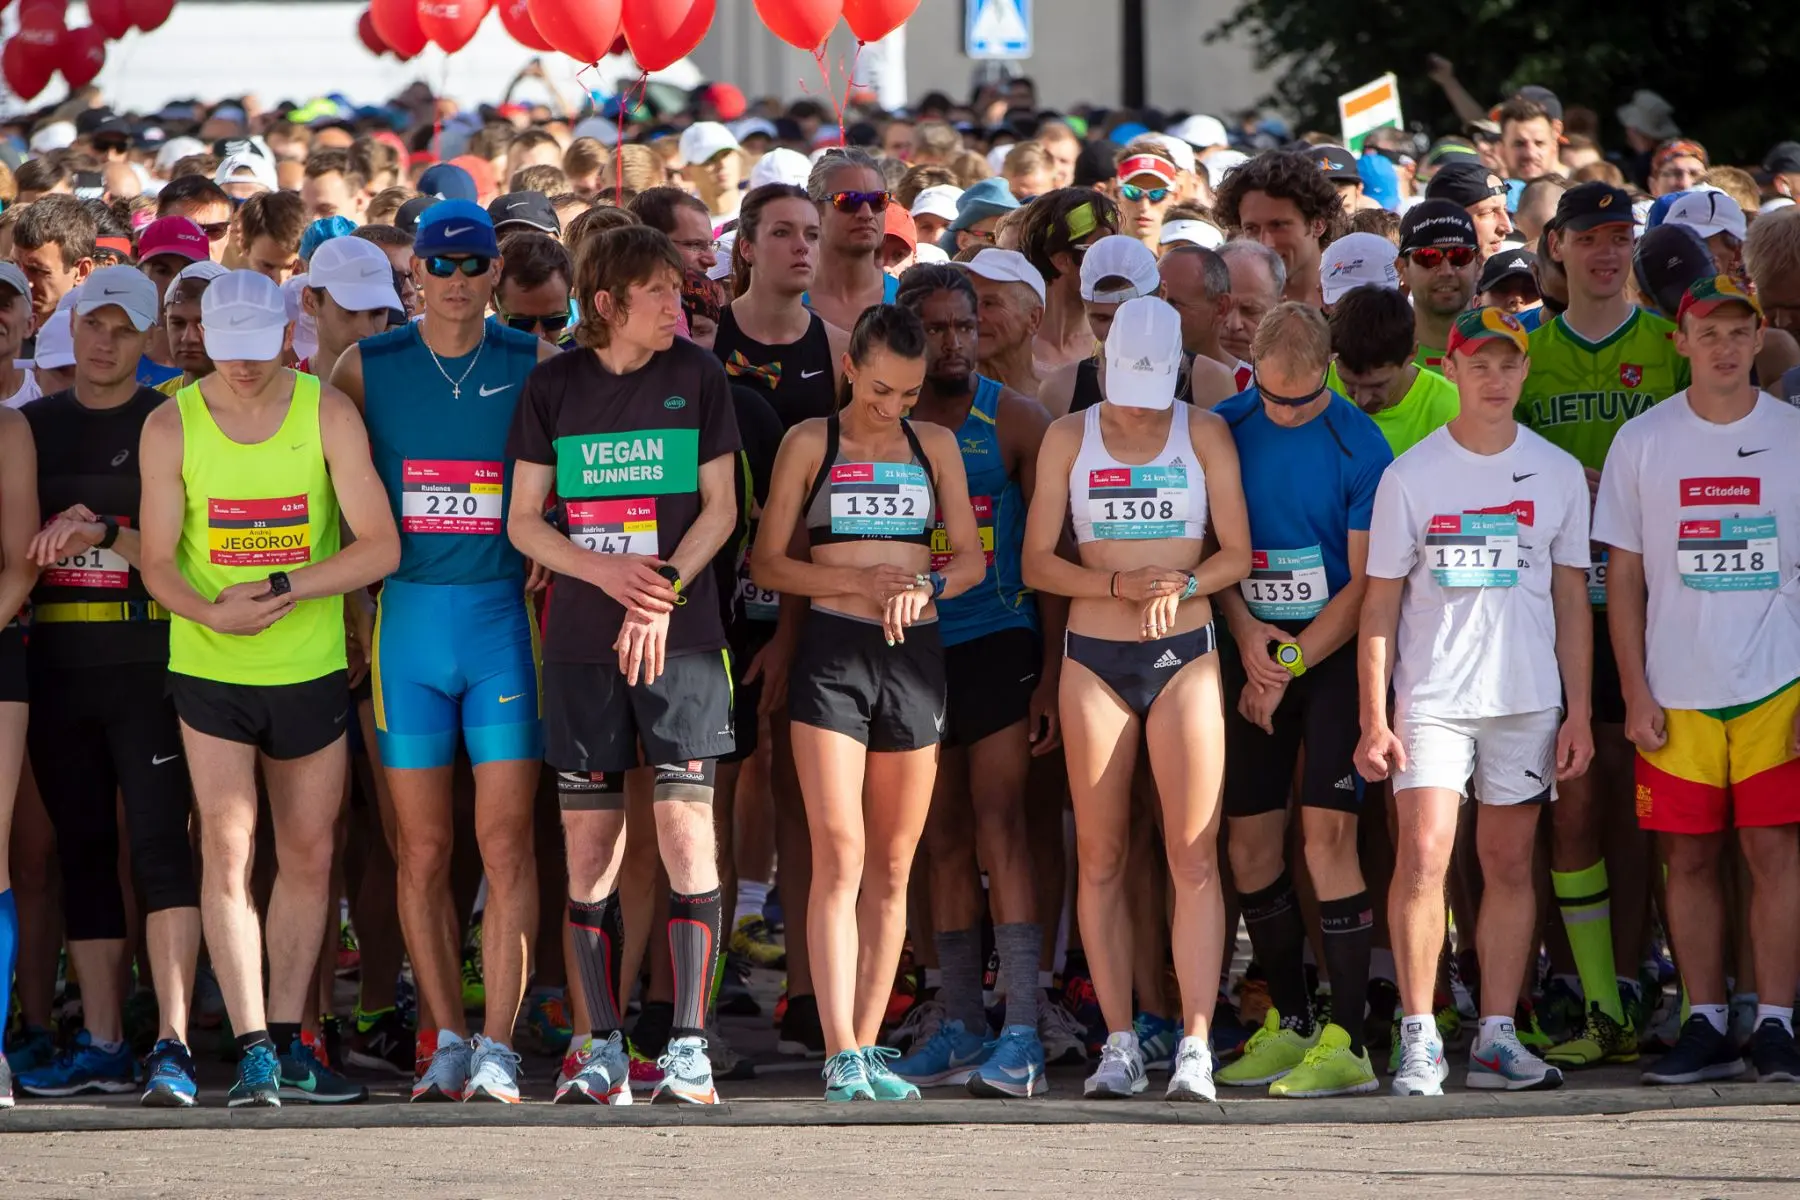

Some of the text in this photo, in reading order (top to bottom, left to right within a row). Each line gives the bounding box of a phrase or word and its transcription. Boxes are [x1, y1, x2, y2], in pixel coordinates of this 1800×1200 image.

[1532, 391, 1657, 428] LIETUVA
[581, 438, 664, 465] VEGAN
[582, 465, 664, 484] RUNNERS
[1704, 485, 1751, 496] Citadele
[426, 495, 478, 515] 220
[847, 495, 915, 516] 1332
[1104, 500, 1173, 520] 1308
[221, 533, 304, 550] JEGOROV
[585, 536, 632, 554] 247
[1436, 548, 1502, 567] 1217
[1694, 552, 1764, 572] 1218
[1251, 582, 1311, 601] 1339
[1153, 658, 1182, 668] adidas
